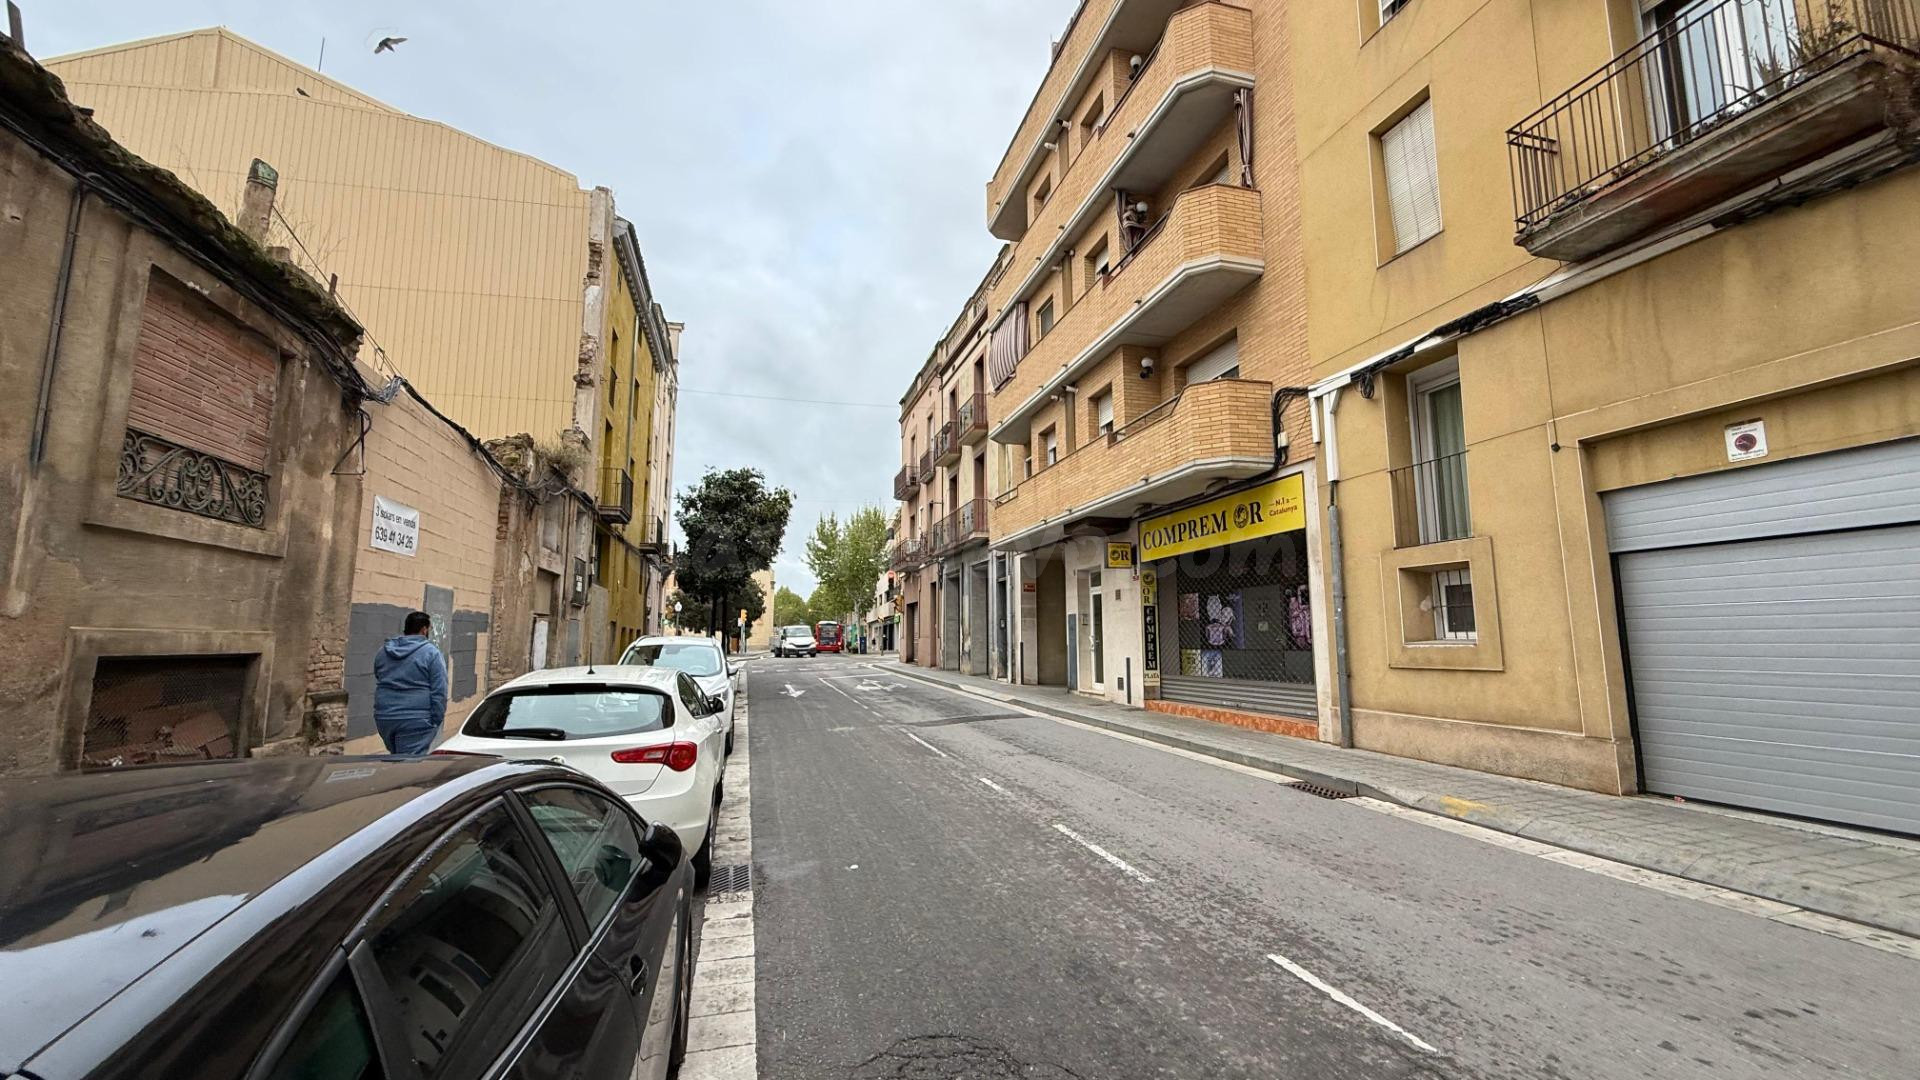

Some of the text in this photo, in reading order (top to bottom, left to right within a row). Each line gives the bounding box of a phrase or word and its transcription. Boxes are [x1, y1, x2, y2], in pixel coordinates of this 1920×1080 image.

[376, 506, 379, 516] 3
[1269, 505, 1298, 517] Catalunya
[376, 526, 387, 542] 639
[397, 532, 405, 546] 34
[1143, 511, 1228, 551] COMPREM
[1234, 501, 1264, 529] OR
[1146, 607, 1156, 669] COMPREM
